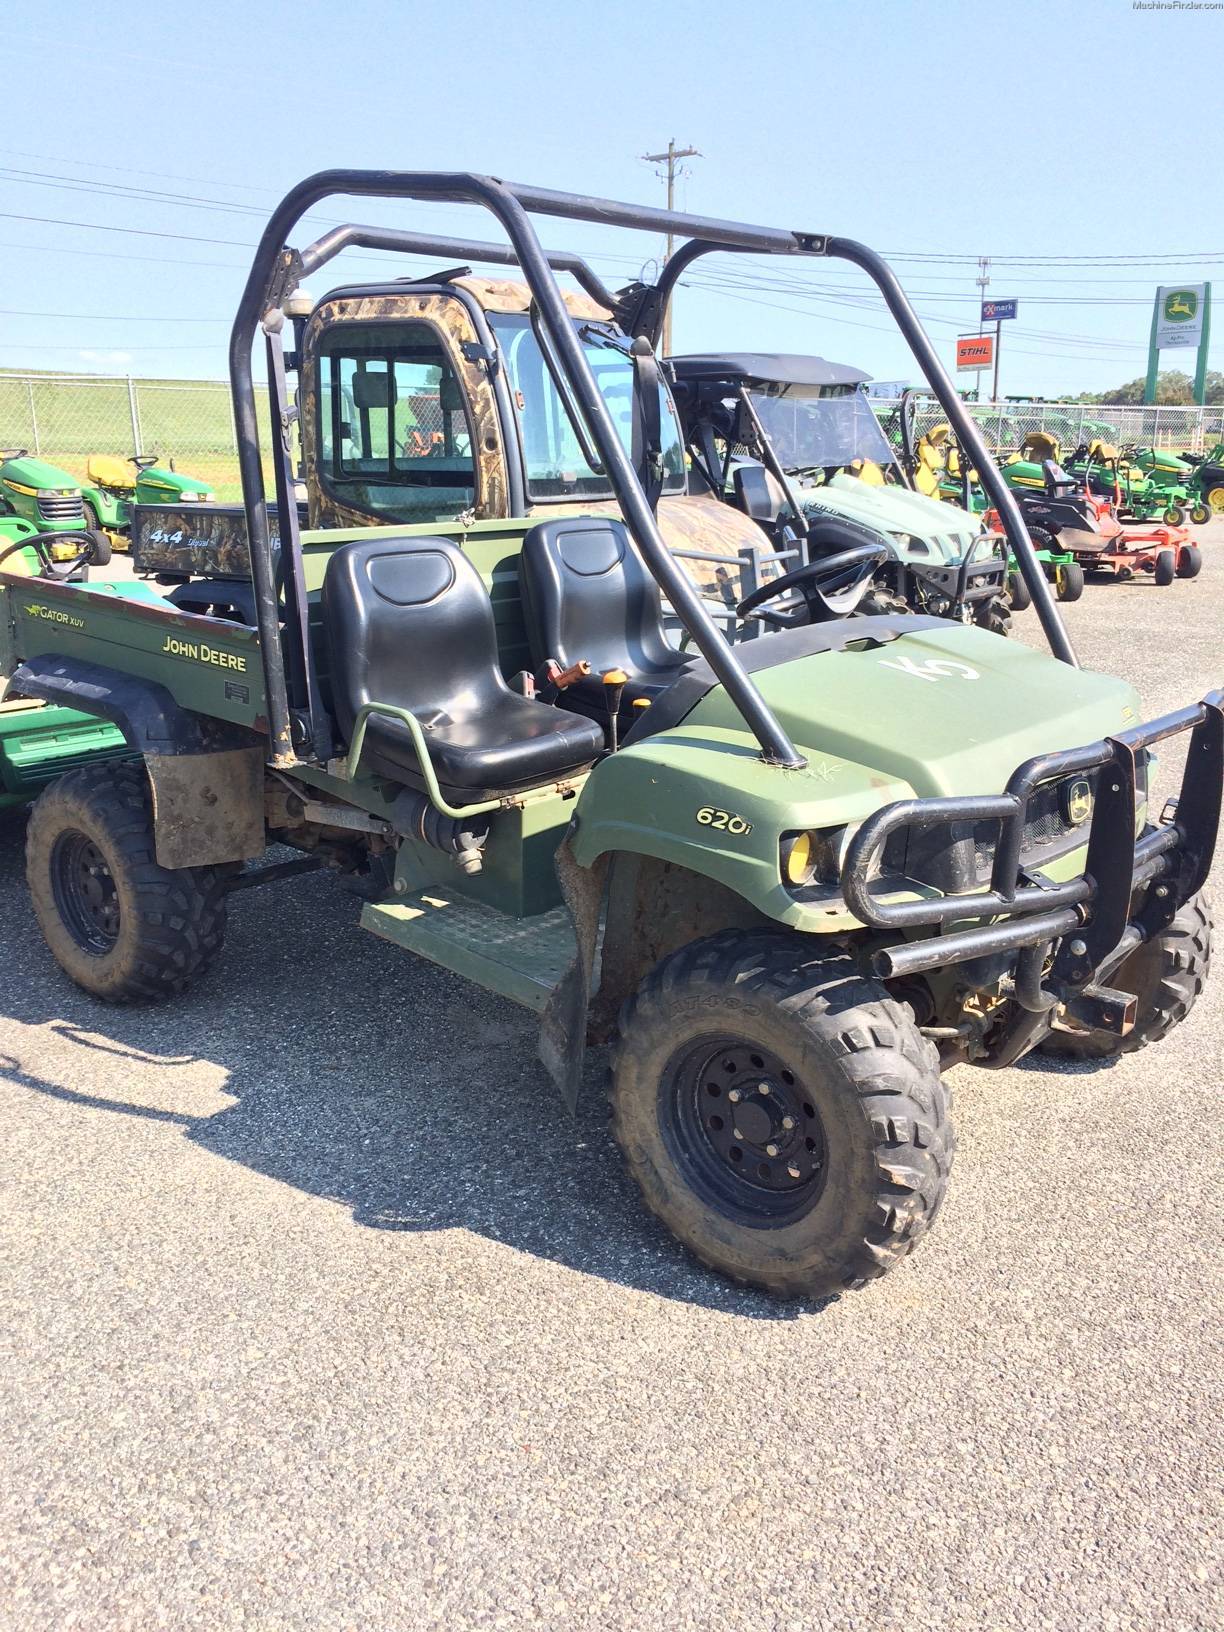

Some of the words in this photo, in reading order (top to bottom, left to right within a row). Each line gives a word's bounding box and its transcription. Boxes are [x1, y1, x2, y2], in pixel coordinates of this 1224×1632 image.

[960, 346, 989, 356] STIHL
[150, 529, 183, 544] 4x4
[40, 606, 68, 624] GATOR
[69, 617, 85, 628] XUV
[162, 636, 198, 659] JOHN
[200, 644, 247, 672] DEERE
[696, 807, 752, 835] 620i
